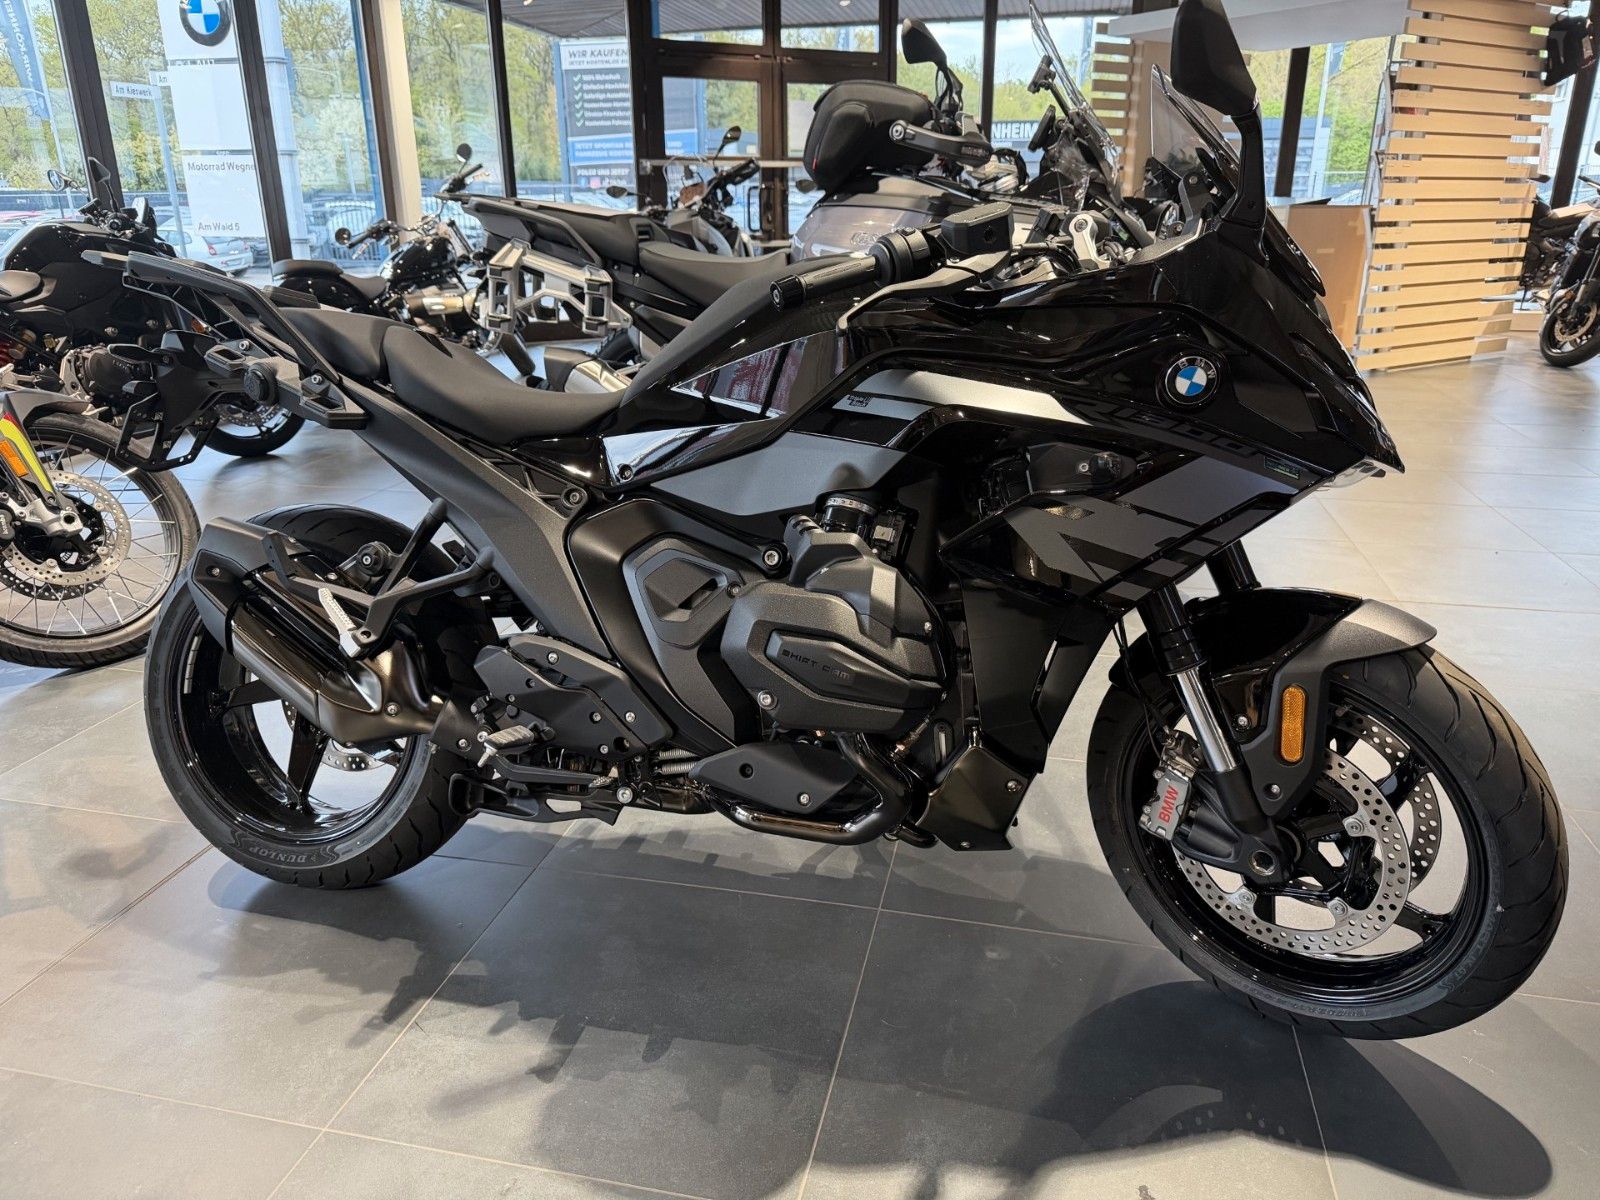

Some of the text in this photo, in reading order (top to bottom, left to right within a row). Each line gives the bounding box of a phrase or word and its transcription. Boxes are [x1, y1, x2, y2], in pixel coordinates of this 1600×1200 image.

[568, 49, 587, 59] WIR
[187, 162, 225, 171] Motorrad
[198, 222, 212, 231] Am
[1179, 358, 1217, 379] BMW
[781, 647, 819, 669] SHIFT
[1158, 784, 1179, 824] BMW
[249, 846, 308, 864] DUNLOP
